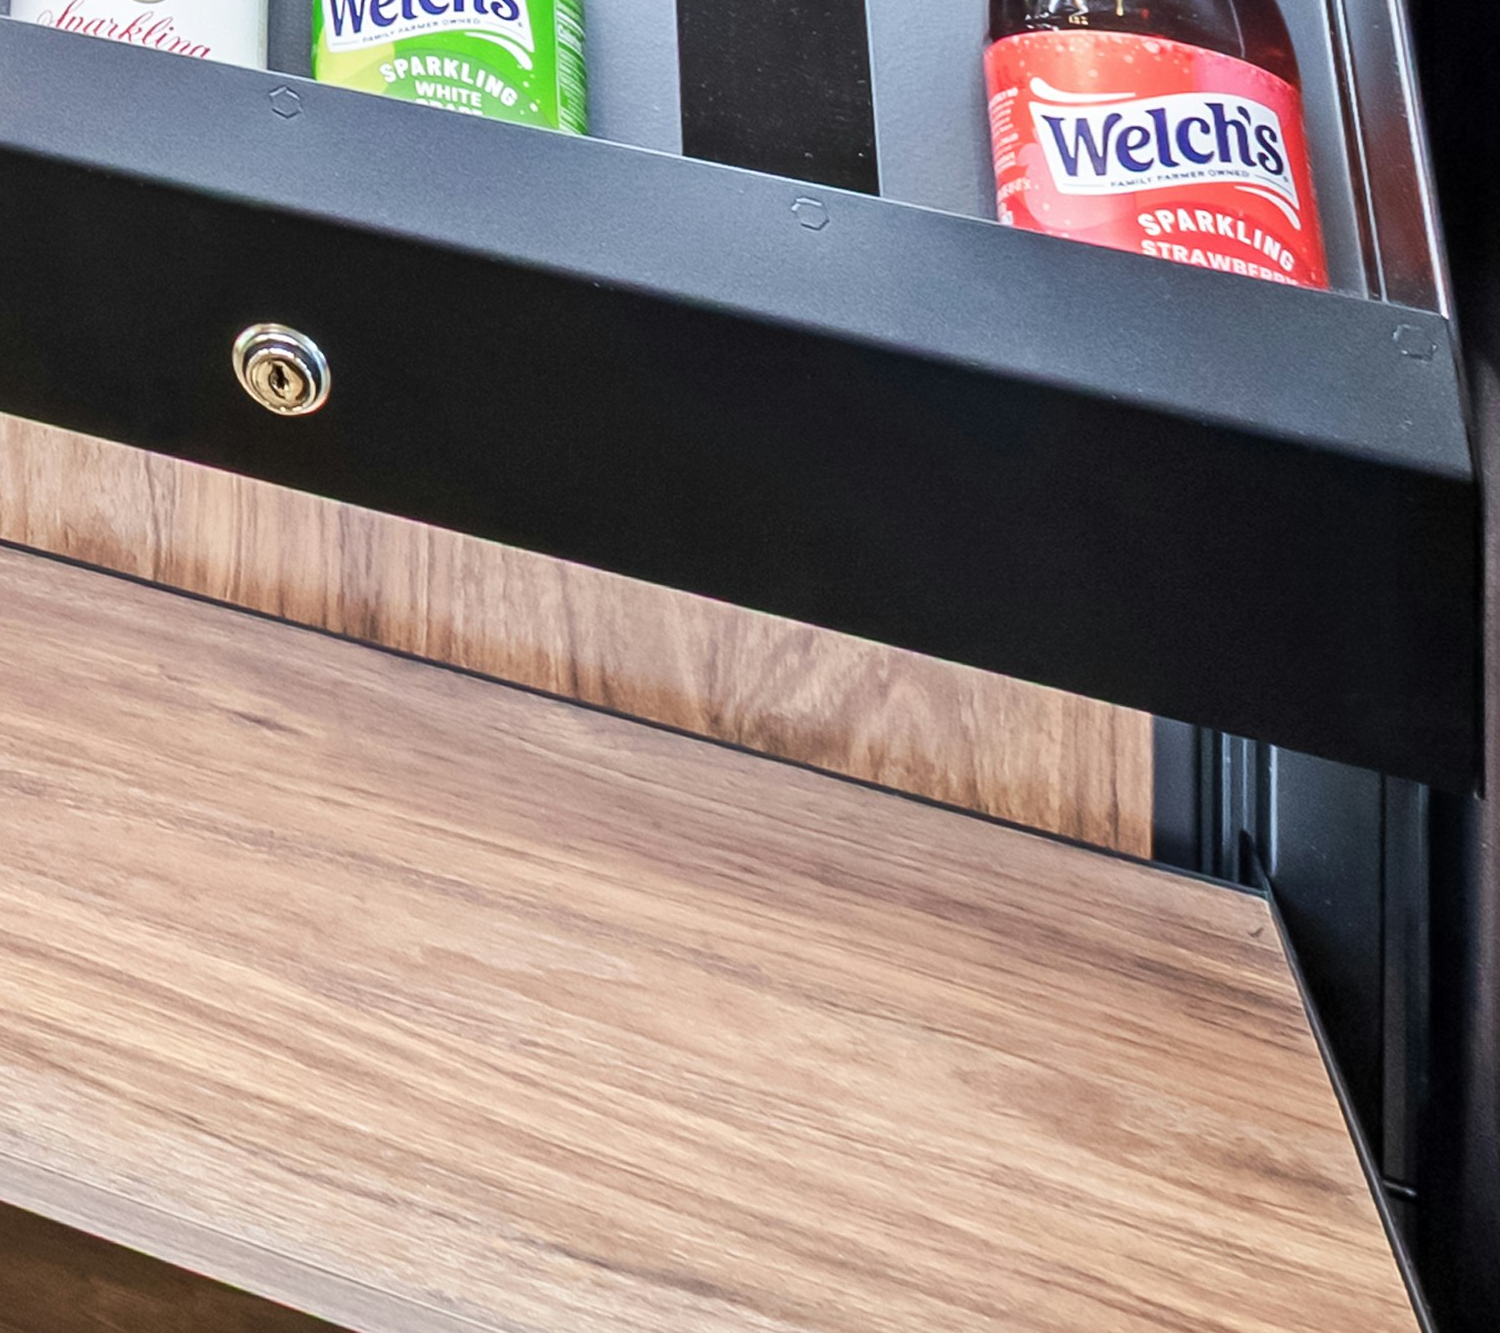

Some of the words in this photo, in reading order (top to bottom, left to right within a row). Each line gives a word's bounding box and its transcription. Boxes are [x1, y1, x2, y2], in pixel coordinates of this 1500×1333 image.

[380, 55, 518, 109] SPARKLING
[415, 79, 482, 107] WHITE
[1041, 102, 1286, 179] Welch's
[1110, 174, 1153, 188] FAMILY
[1157, 171, 1206, 183] FARMER
[1208, 168, 1251, 179] OWNED
[1138, 207, 1295, 272] SPARKLING
